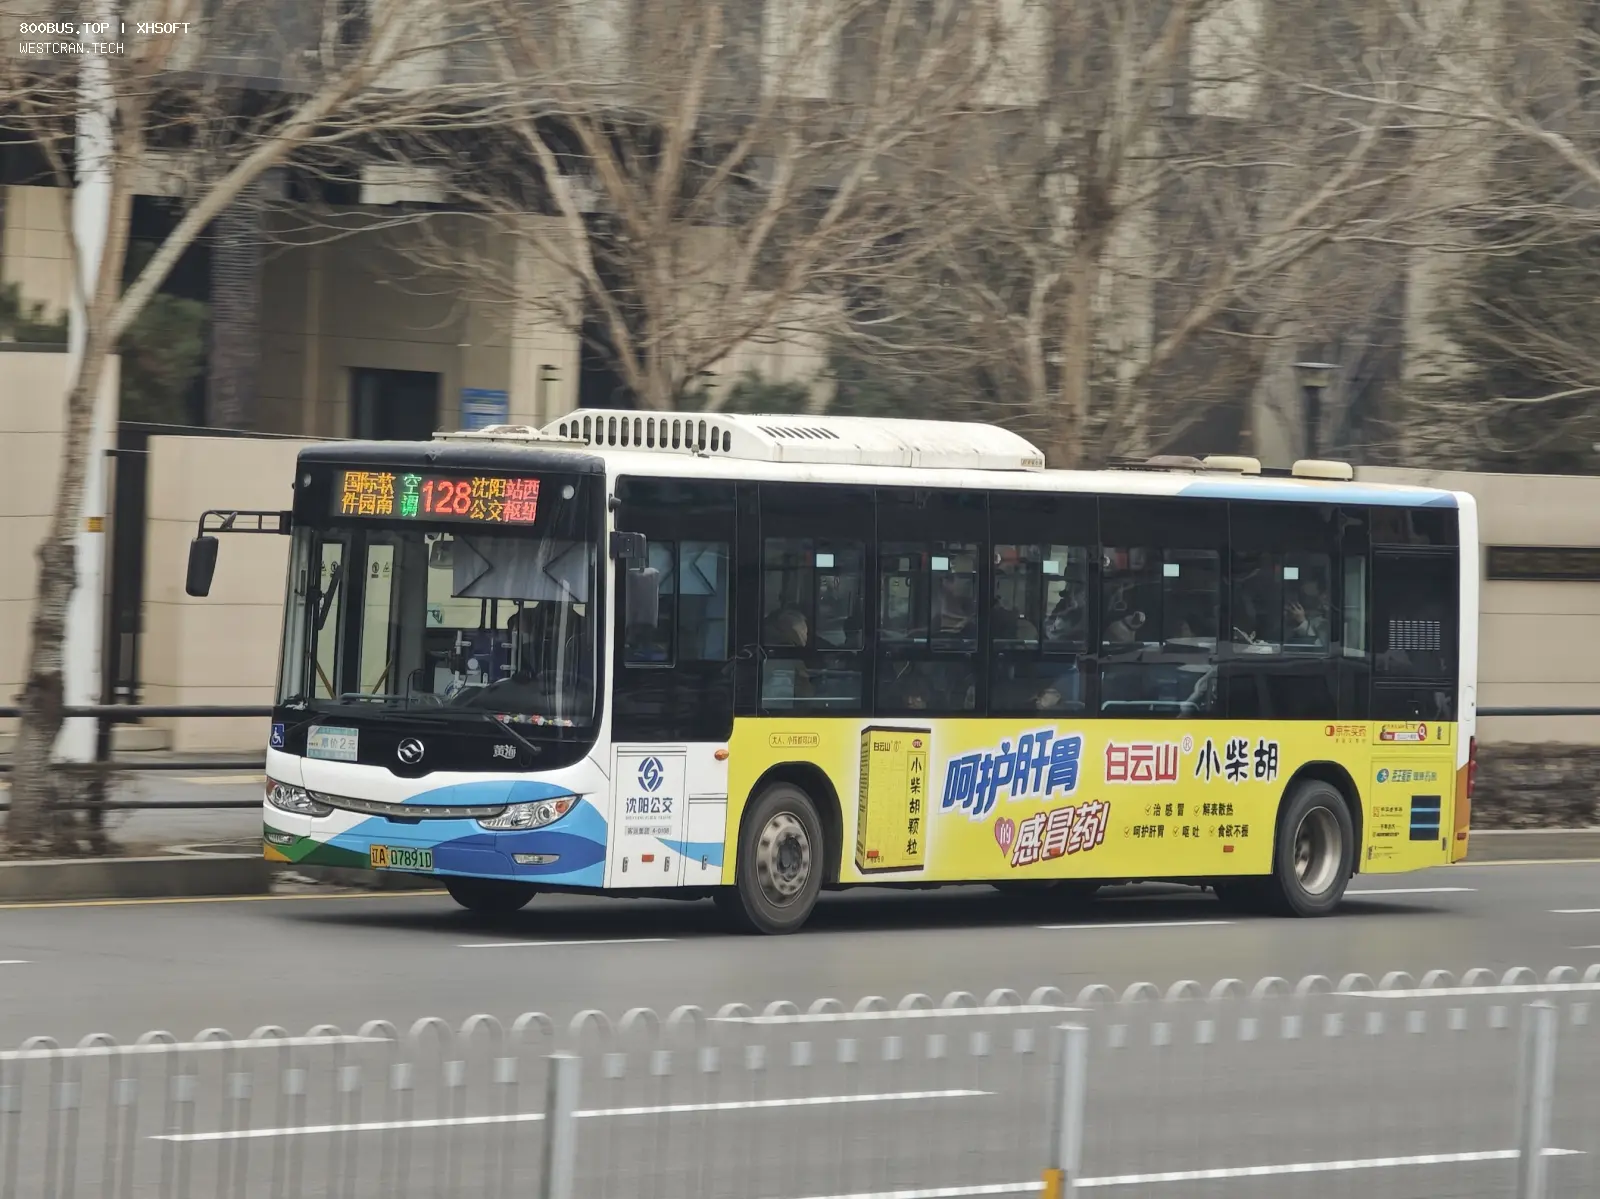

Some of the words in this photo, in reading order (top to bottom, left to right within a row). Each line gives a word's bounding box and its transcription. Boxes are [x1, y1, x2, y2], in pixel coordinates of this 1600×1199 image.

[344, 471, 395, 495] 国际软
[401, 473, 422, 517] 空调
[472, 477, 540, 501] 沈阳站西
[341, 492, 394, 515] 件园南
[422, 479, 472, 514] 128
[470, 498, 537, 522] 公交枢纽
[942, 729, 1082, 816] 呵护肝胃
[1105, 742, 1179, 782] 白云山
[1194, 739, 1279, 782] 小柴胡
[625, 796, 674, 814] 沈阳公交
[905, 756, 922, 856] 小柴胡颗粒
[1152, 802, 1185, 817] 治感冒
[1202, 802, 1235, 817] 解表散热
[1132, 825, 1165, 839] 呵护肝胃
[1181, 825, 1200, 838] 呕吐
[1217, 824, 1249, 838] 食欲不振
